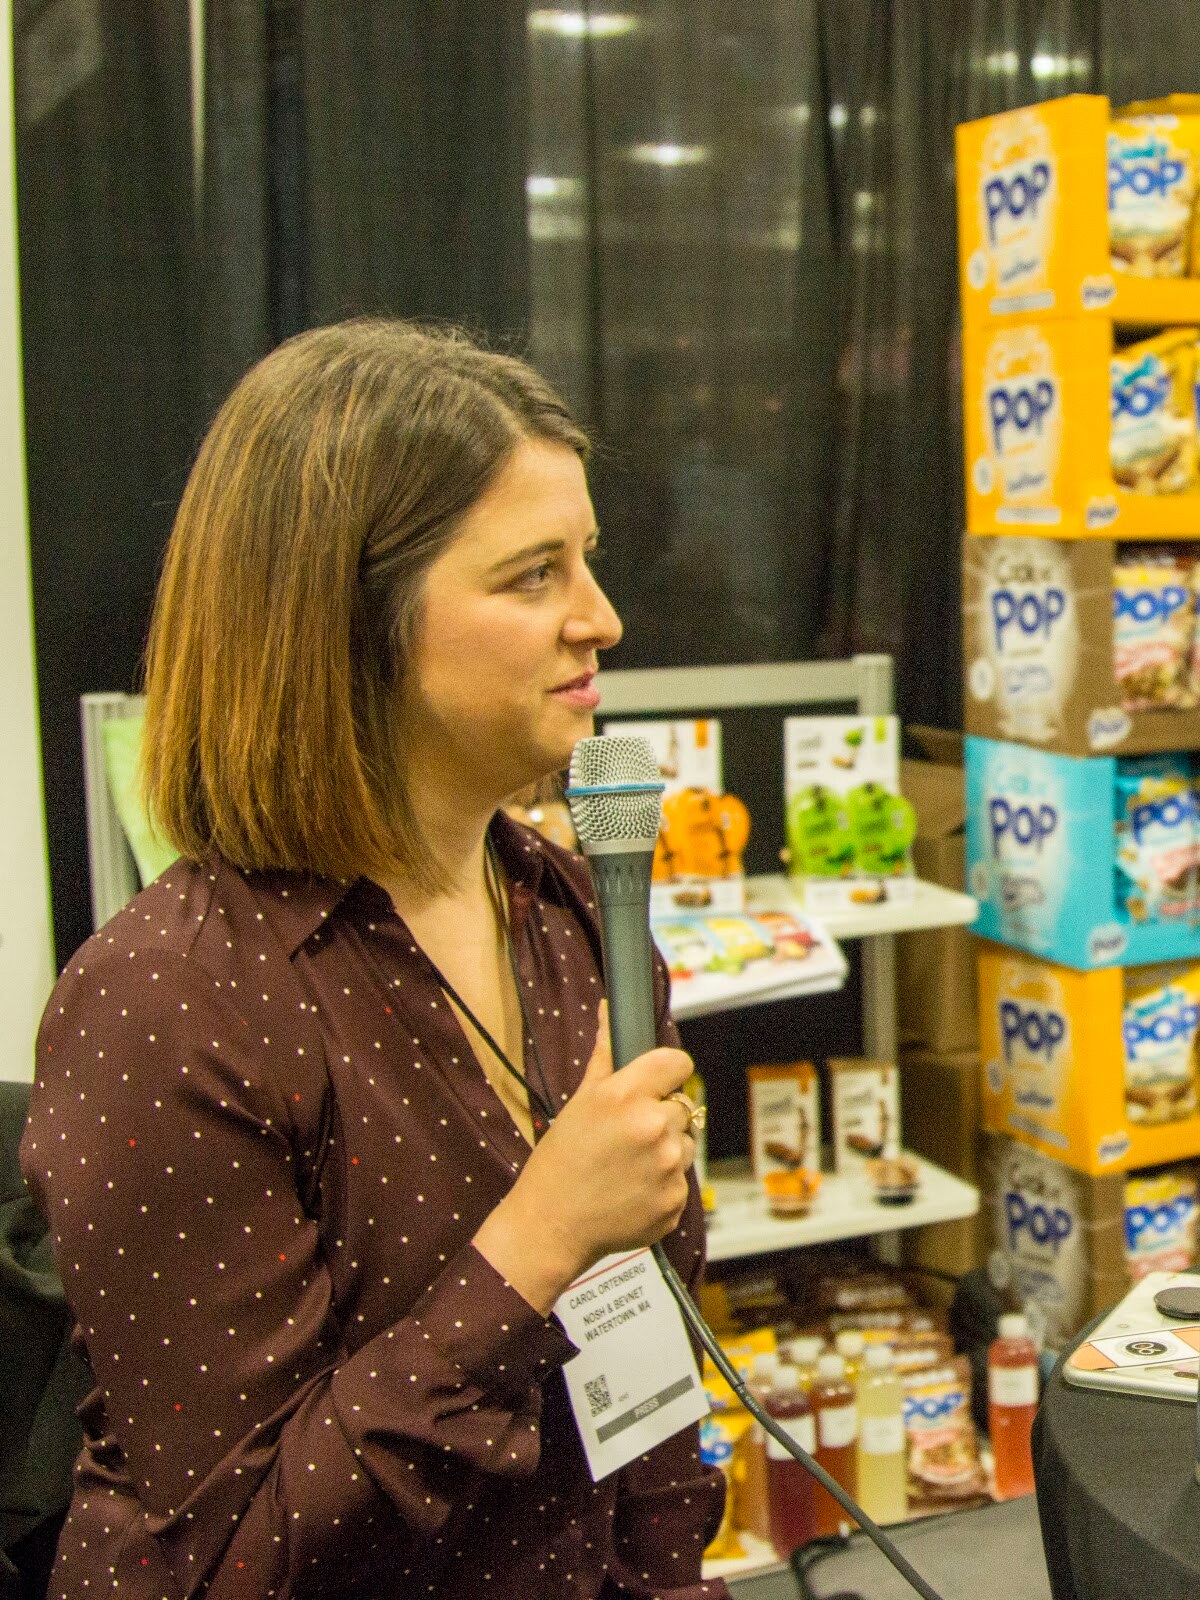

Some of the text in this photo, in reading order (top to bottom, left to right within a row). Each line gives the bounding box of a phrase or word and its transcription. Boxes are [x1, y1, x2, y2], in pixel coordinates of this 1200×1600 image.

[985, 163, 1050, 247] POP
[990, 380, 1054, 458] POP
[991, 588, 1065, 655] POP
[989, 797, 1058, 860] POP
[1000, 1000, 1065, 1065] POP
[1123, 1001, 1200, 1061] POP
[1006, 1191, 1072, 1252] POP
[1124, 1196, 1197, 1252] POP
[570, 1264, 646, 1310] CAROL ORTENBERG
[583, 1287, 644, 1326] NOSH & BEVNET
[638, 1300, 651, 1313] MA
